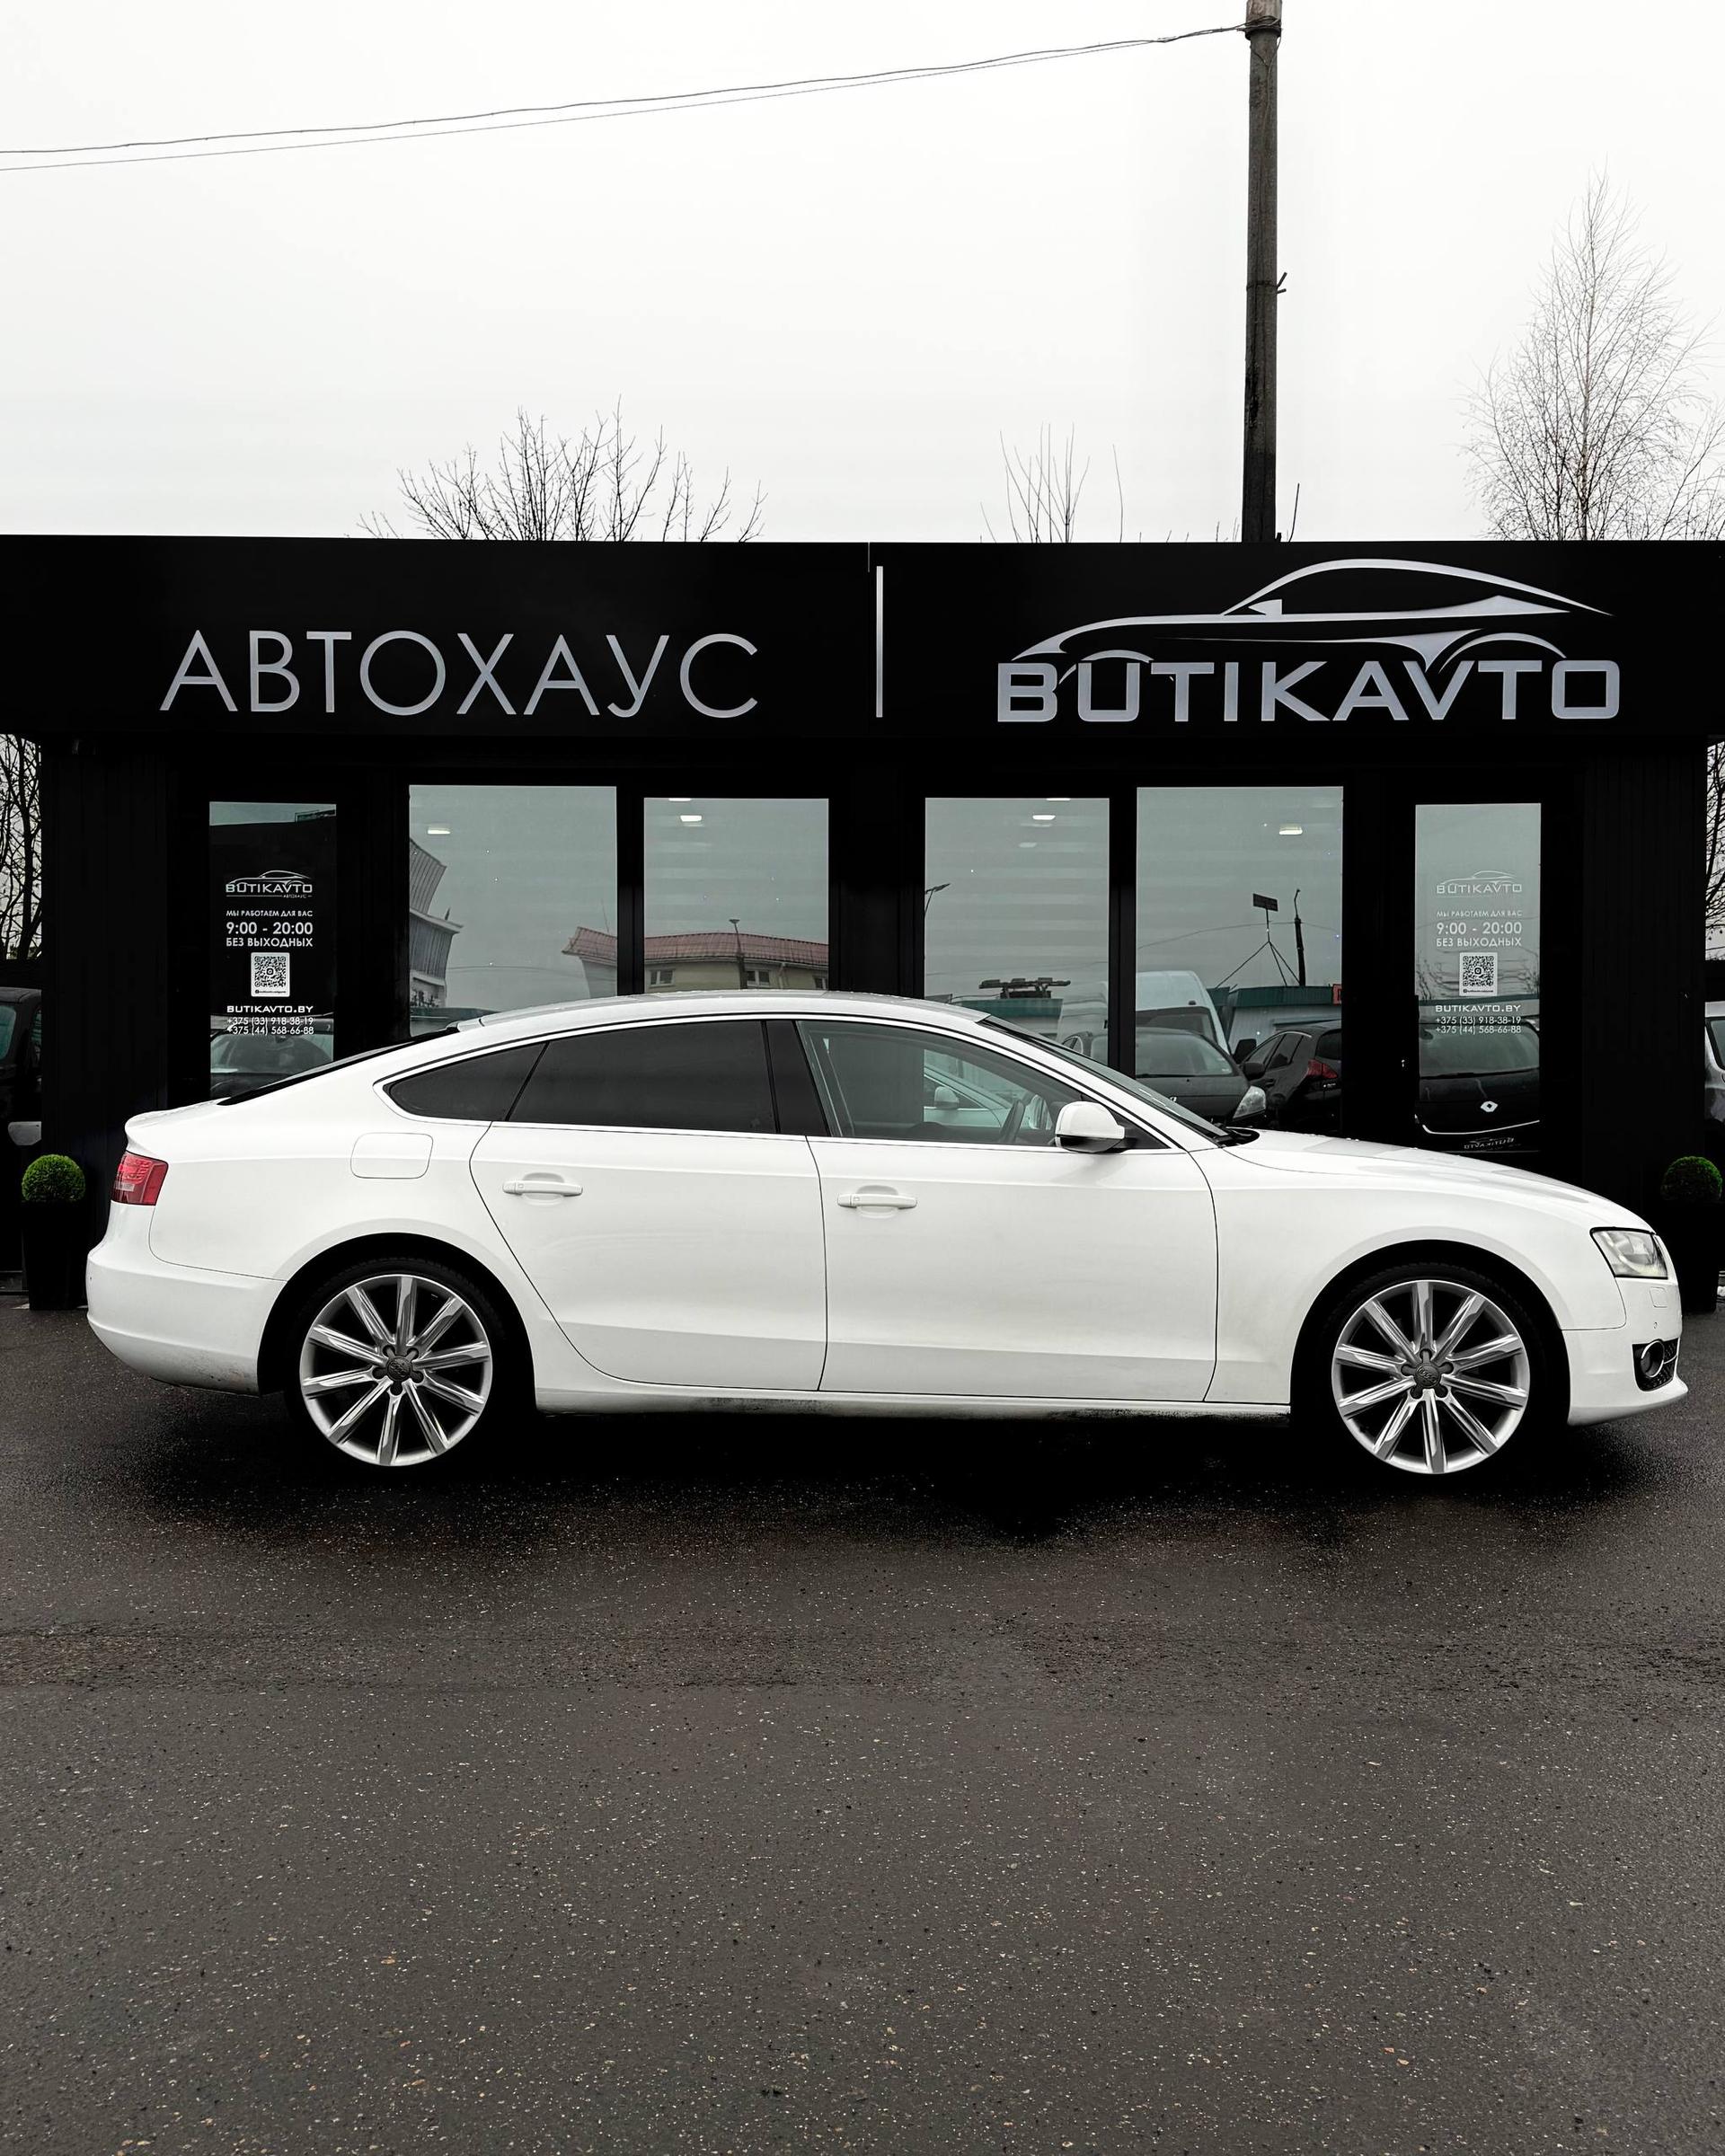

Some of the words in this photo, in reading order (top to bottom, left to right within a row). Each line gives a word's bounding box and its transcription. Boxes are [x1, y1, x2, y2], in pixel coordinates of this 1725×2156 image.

[159, 629, 758, 719] АВТОХАУС
[997, 659, 1621, 722] BUTIKAVTO
[226, 883, 313, 893] BUTIKAVTO
[1437, 883, 1522, 894] BUTIKAVTO
[226, 922, 258, 934] 9:00
[272, 922, 314, 934] 20:00
[1437, 922, 1466, 934] 9:00
[1482, 922, 1522, 934] 20:00
[226, 937, 244, 947] БЕЗ
[247, 937, 314, 948] ВЫХОДНЫХ
[1437, 937, 1454, 947] БЕЗ
[1456, 937, 1522, 947] ВЫХОДНЫХ
[226, 1005, 314, 1013] BUTIKAVTO.BY
[1435, 1004, 1521, 1012] BUTIKAVTO.BY
[227, 1017, 249, 1025] +375
[252, 1016, 268, 1026] (33)
[270, 1017, 314, 1025] 918-38-19
[1436, 1016, 1457, 1024] +375
[1459, 1016, 1476, 1025] (33)
[1479, 1016, 1521, 1024] 918-38-19
[252, 1026, 268, 1036] (44)
[270, 1026, 314, 1035] 568-66-88
[1436, 1025, 1457, 1034] +375
[1459, 1025, 1476, 1035] (44)
[1479, 1025, 1522, 1034] 568-66-88
